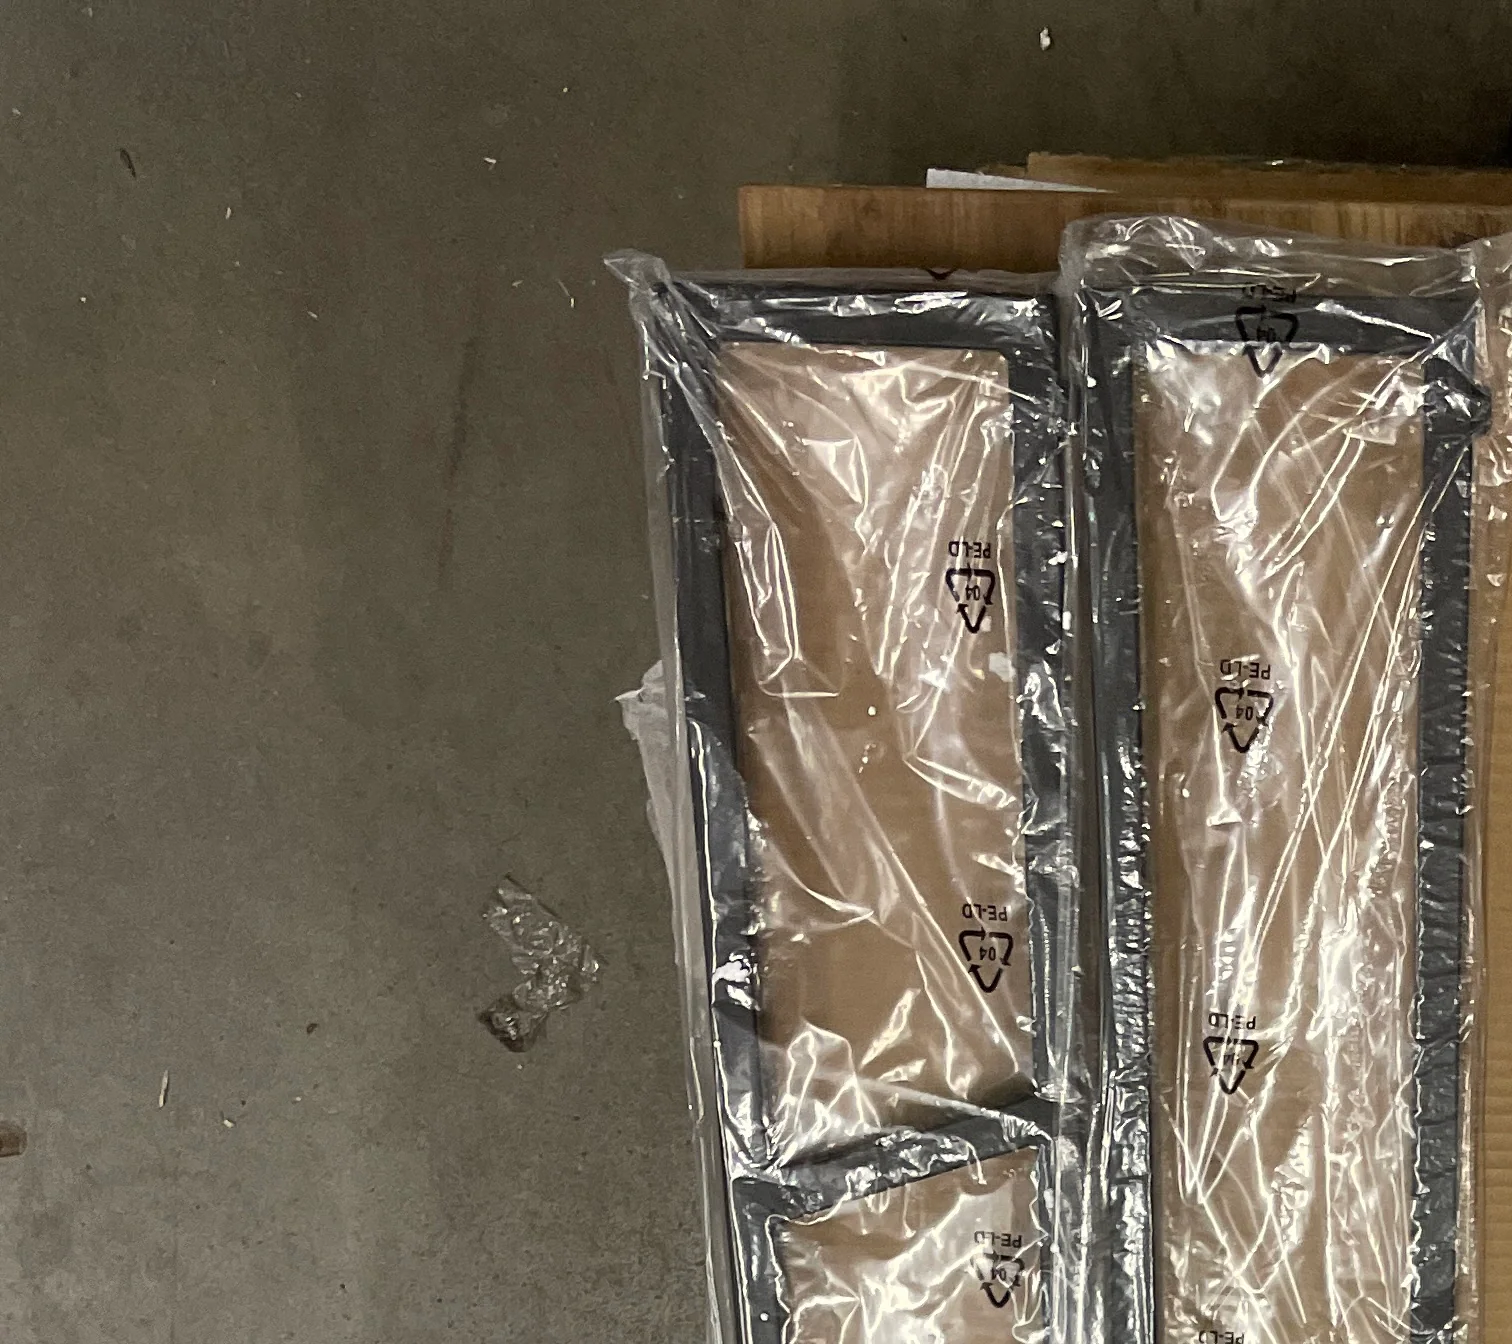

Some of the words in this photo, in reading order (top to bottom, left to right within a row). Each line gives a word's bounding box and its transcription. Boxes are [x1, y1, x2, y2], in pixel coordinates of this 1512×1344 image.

[947, 540, 992, 559] PE-LD
[964, 585, 981, 602] 04
[1219, 658, 1272, 680] PE-LD
[1235, 704, 1254, 722] 04
[961, 902, 1008, 922] PE-LD
[978, 946, 997, 962] 04
[973, 1230, 1023, 1249] PE-LD
[990, 1267, 1008, 1281] 04
